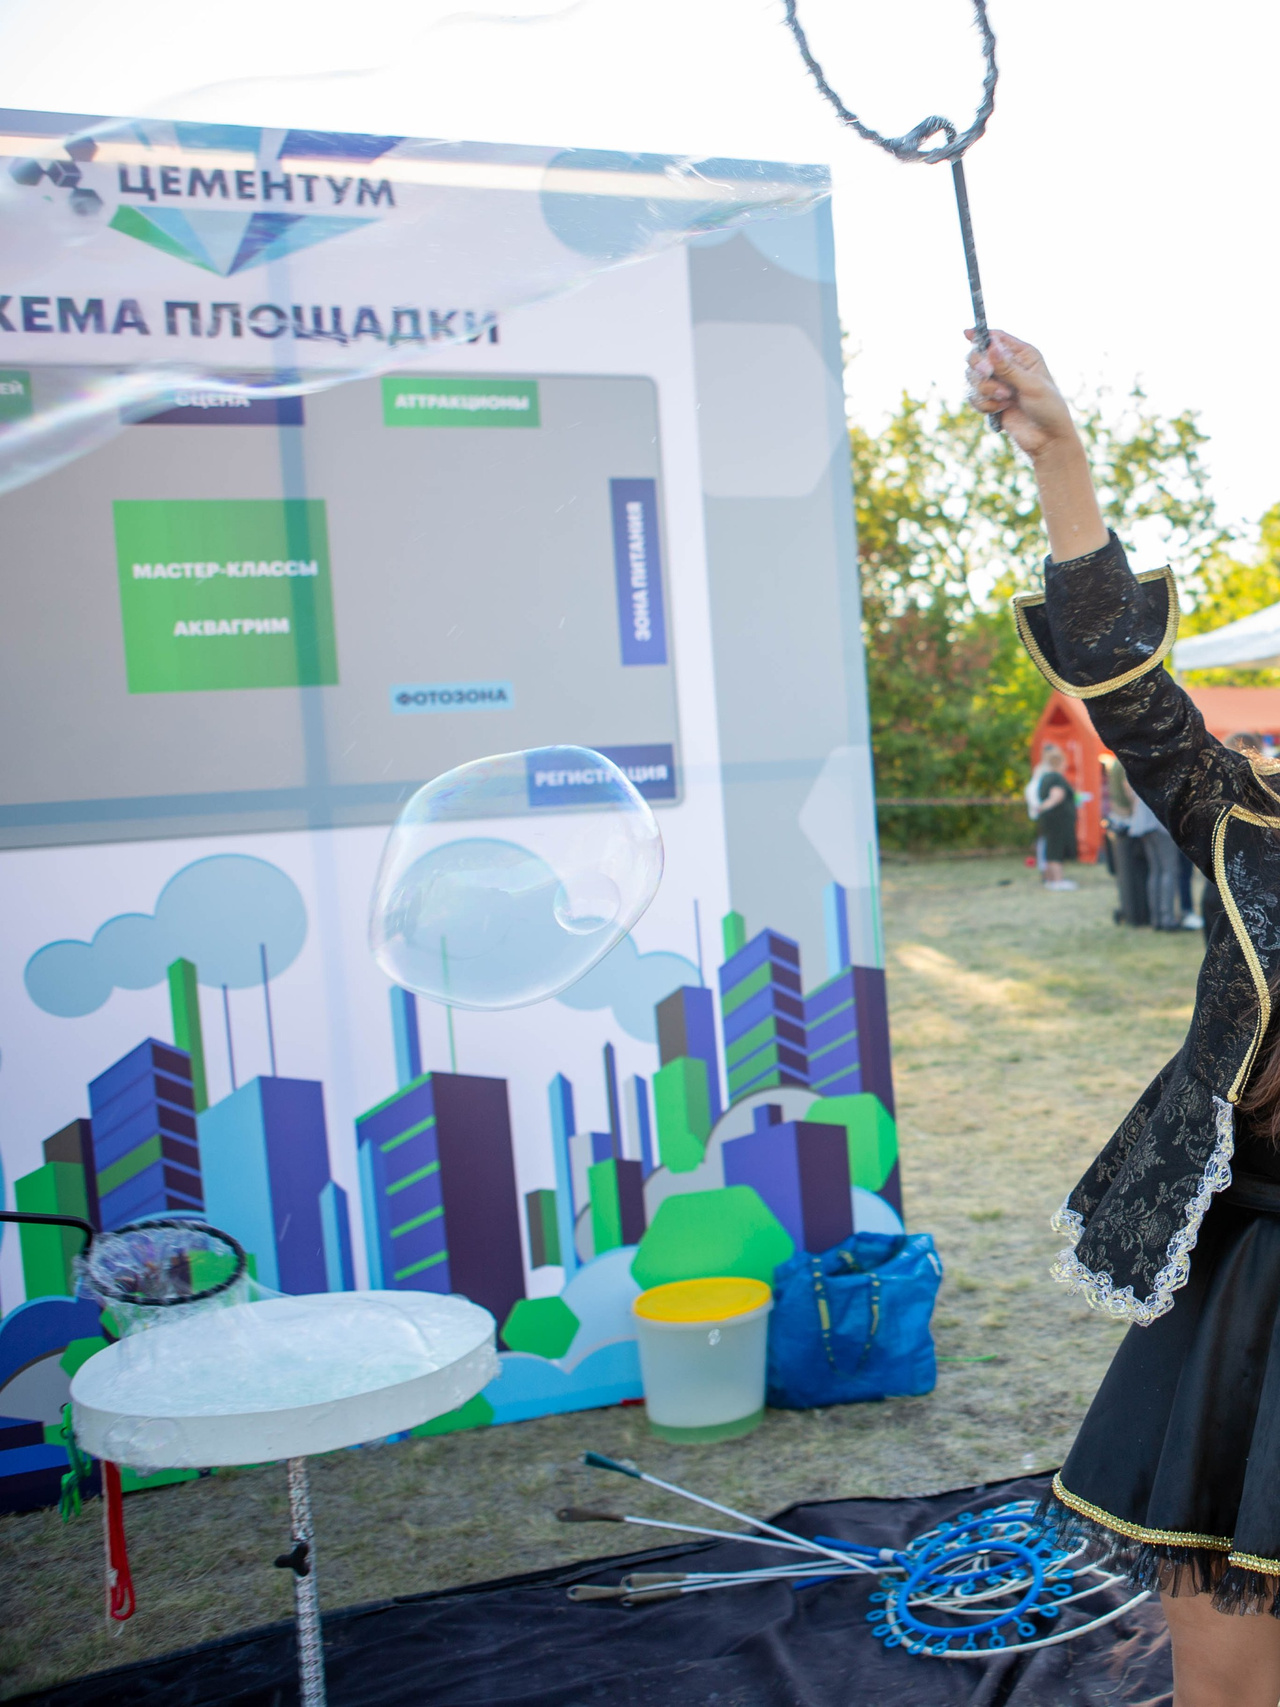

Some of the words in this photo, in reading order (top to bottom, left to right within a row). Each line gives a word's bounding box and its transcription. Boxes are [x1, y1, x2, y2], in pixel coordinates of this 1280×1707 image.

[118, 163, 397, 207] ЦЕМЕНТУМ
[165, 300, 499, 346] ПЛОЩАДКИ
[394, 393, 530, 411] АТТРАКЦИОНЫ
[626, 501, 648, 588] ПИТАНИЯ
[132, 560, 319, 579] МАСТЕР-КЛАССЫ
[173, 617, 291, 637] АКВАГРИМ
[632, 590, 652, 641] ЗОНА
[395, 689, 508, 706] ФОТОЗОНА
